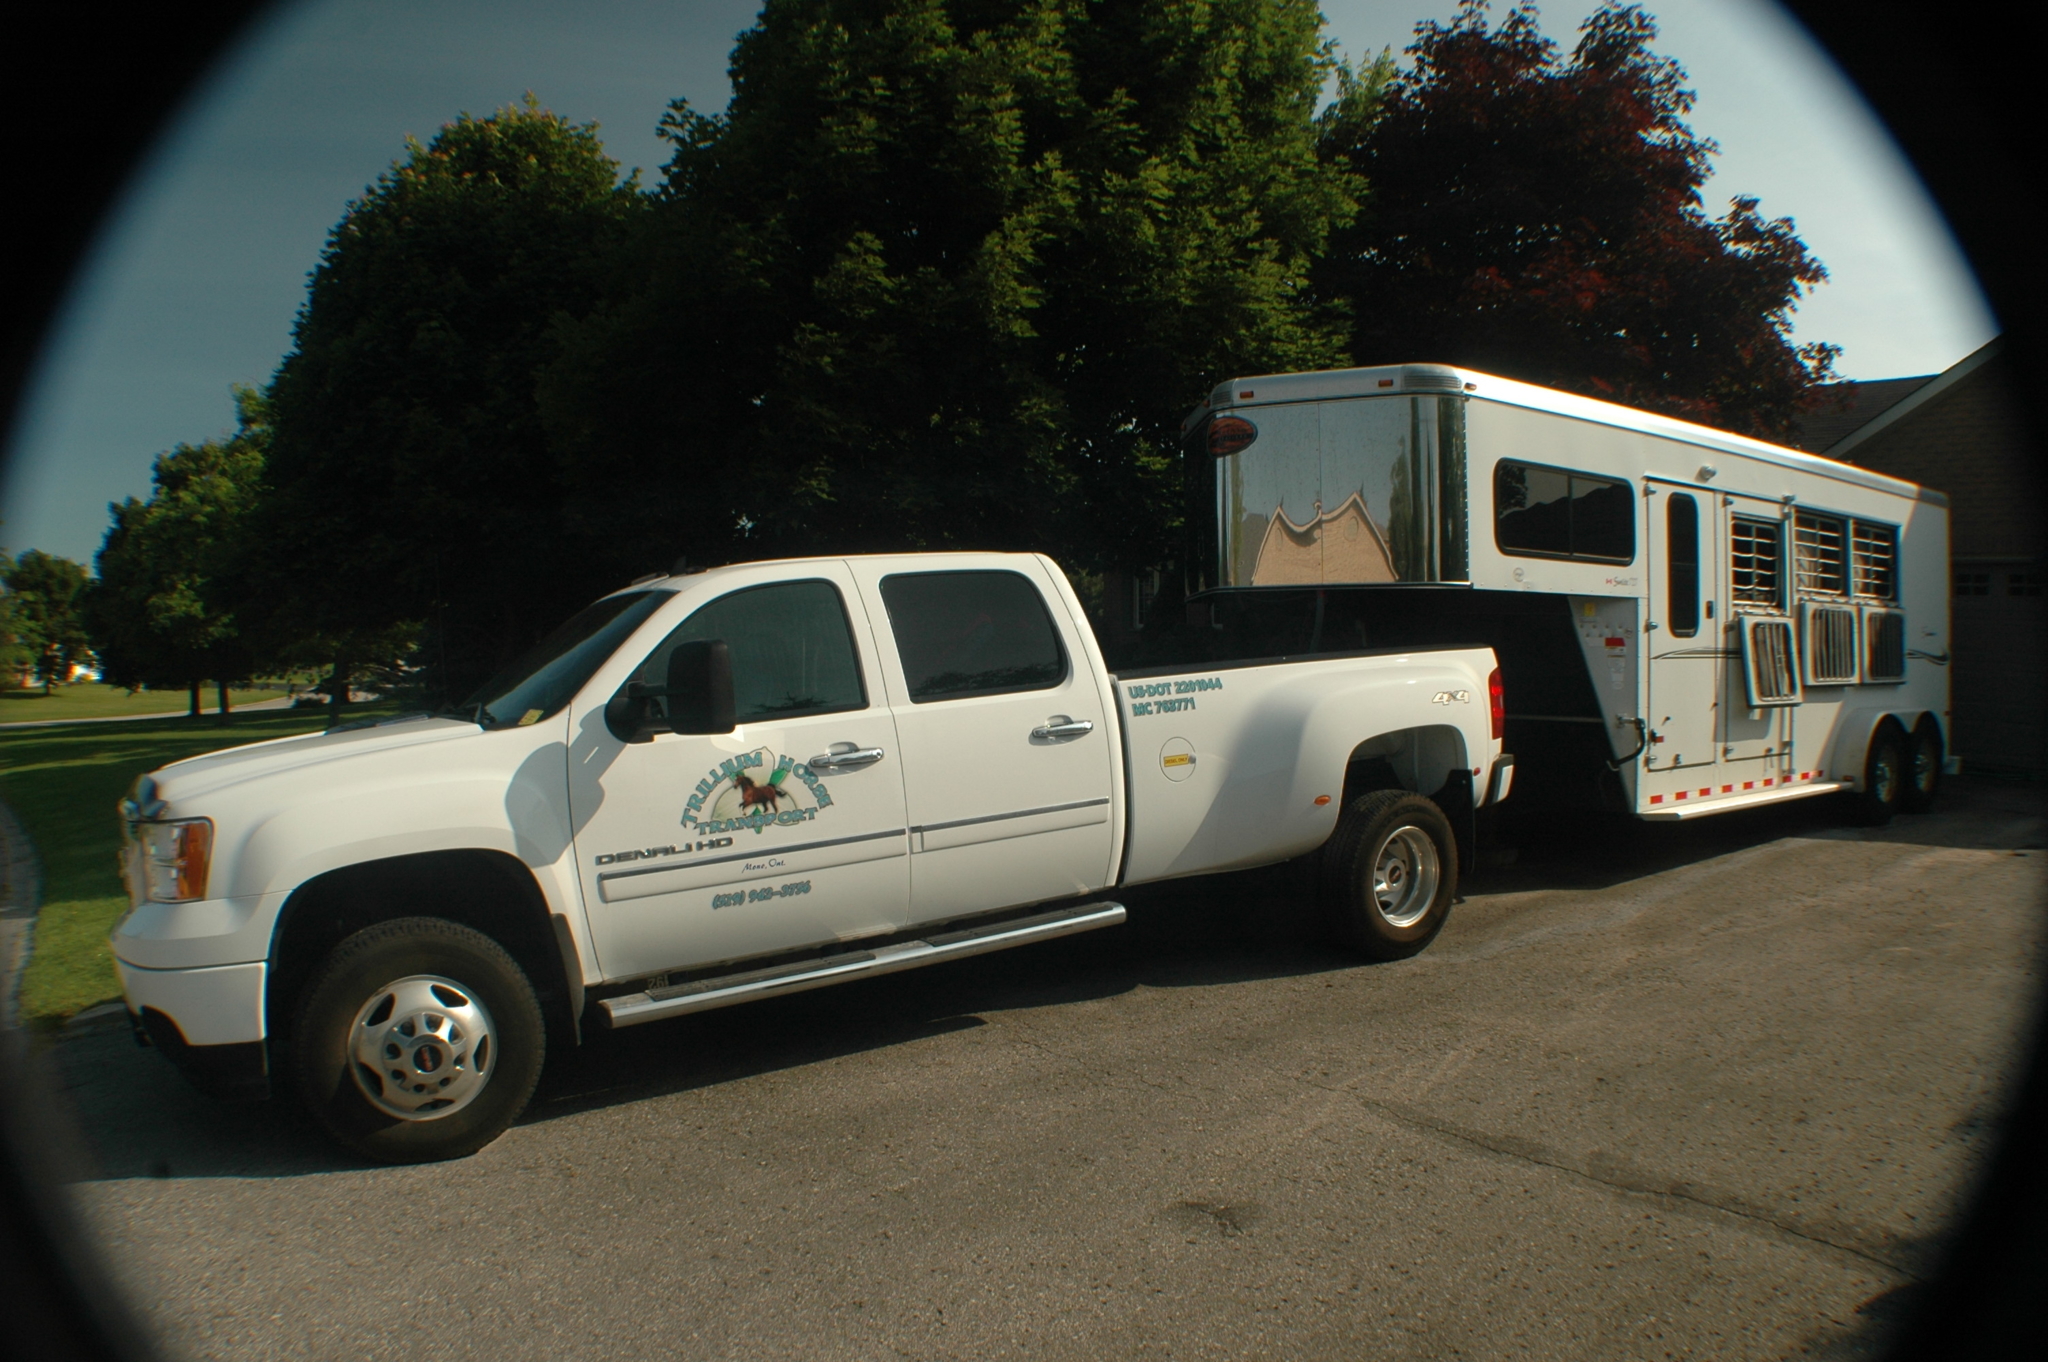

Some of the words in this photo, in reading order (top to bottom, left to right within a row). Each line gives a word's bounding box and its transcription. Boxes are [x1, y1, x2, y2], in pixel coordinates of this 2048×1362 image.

[1131, 702, 1153, 717] MC
[681, 751, 764, 830] TRILLIUM
[777, 754, 835, 810] HORSE
[693, 806, 818, 836] TRANSPORT
[595, 842, 694, 866] DENALI
[696, 836, 734, 852] HD
